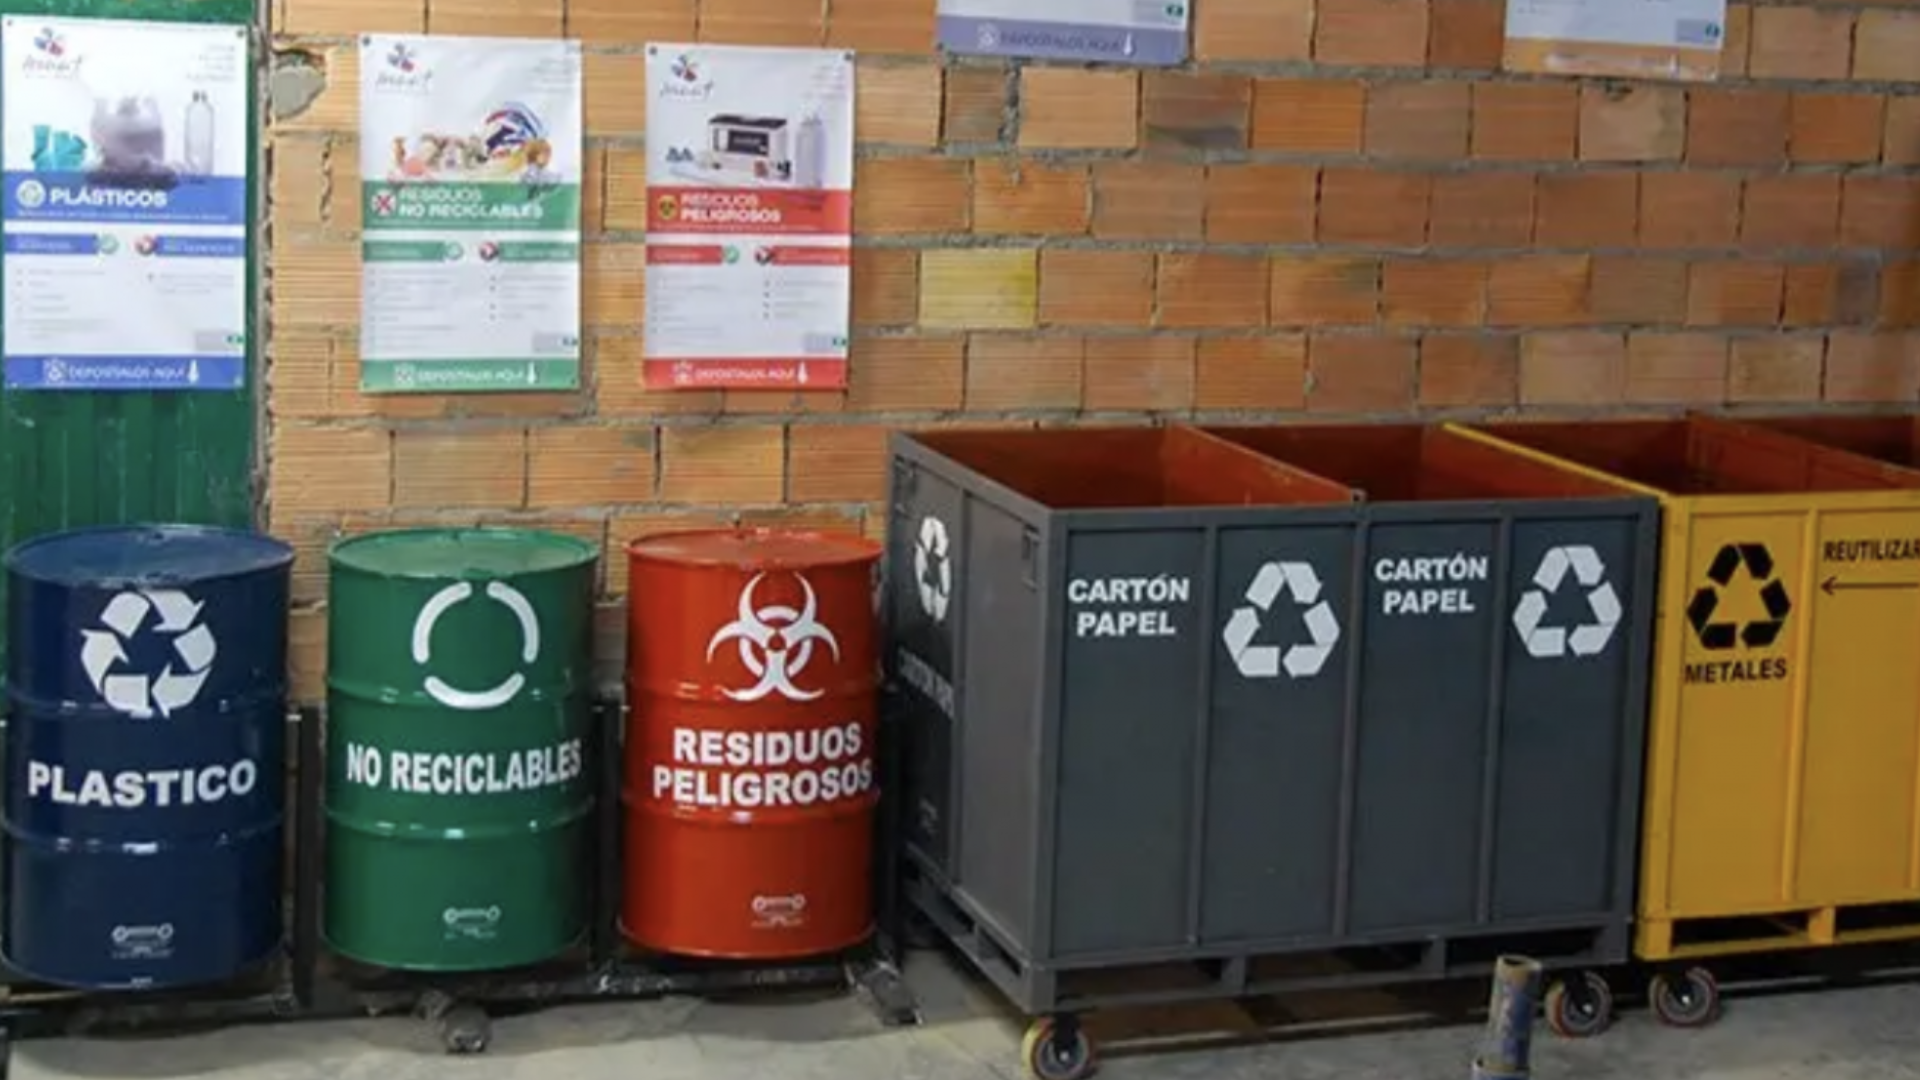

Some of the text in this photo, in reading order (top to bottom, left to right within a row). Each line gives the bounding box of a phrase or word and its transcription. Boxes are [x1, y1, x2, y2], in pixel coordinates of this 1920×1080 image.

[50, 185, 168, 207] PLÁSTICOS
[401, 188, 481, 202] RESIDUOS
[401, 204, 543, 219] NO RECICLABLES
[681, 208, 781, 222] PELIGROSOS
[1374, 554, 1488, 582] CARTÓN
[1068, 575, 1190, 602] CARTÓN
[1382, 590, 1475, 614] PAPEL
[1076, 612, 1176, 637] PAPEL
[1684, 658, 1787, 683] METALES
[673, 722, 862, 766] RESIDUOS
[347, 740, 582, 794] NO RECICLABLES
[28, 759, 256, 807] PLASTICO
[653, 758, 872, 806] PELIGROSOS
